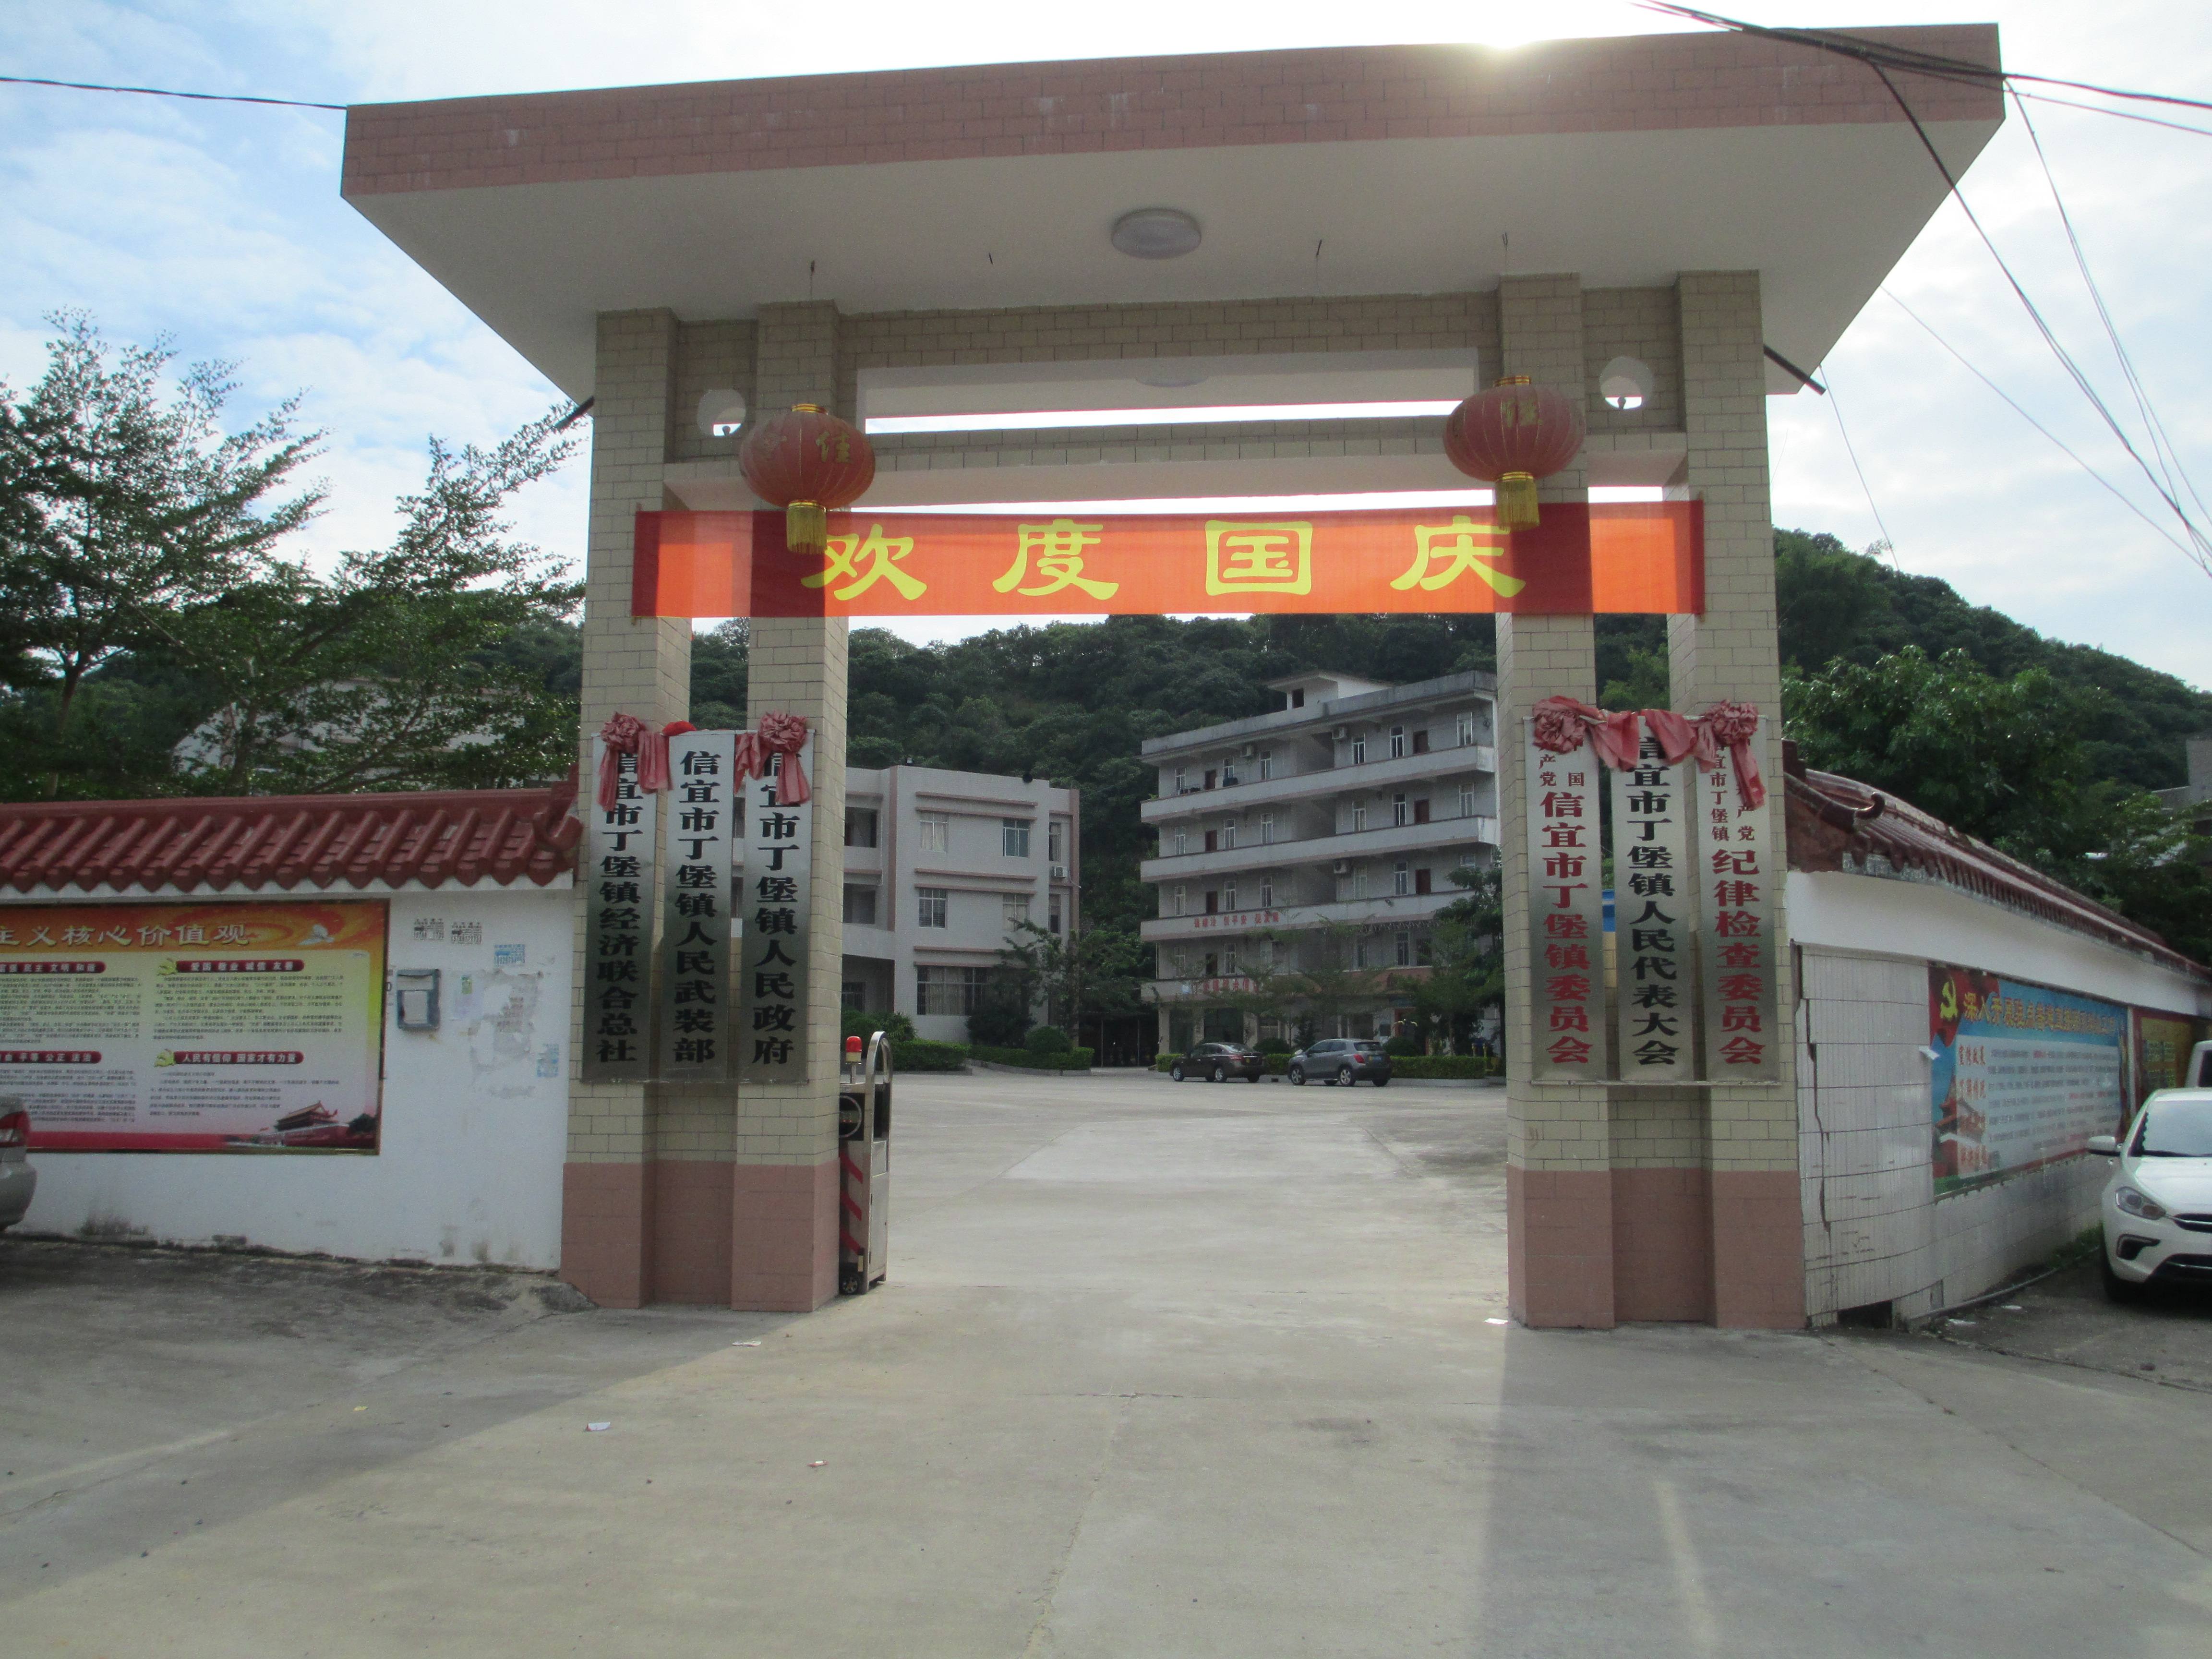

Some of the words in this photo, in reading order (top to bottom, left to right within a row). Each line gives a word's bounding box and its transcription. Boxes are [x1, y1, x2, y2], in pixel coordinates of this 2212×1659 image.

[801, 515, 1526, 601] 欢度国庆
[1710, 745, 1730, 841] 宜市丁堡镇
[0, 925, 249, 947] 主义核心价值观
[673, 750, 721, 1063] 信宜市丁堡镇人民武装部
[1539, 791, 1593, 1064] 信宜市丁堡镇委员会
[1711, 849, 1766, 1064] 纪律检查委员会
